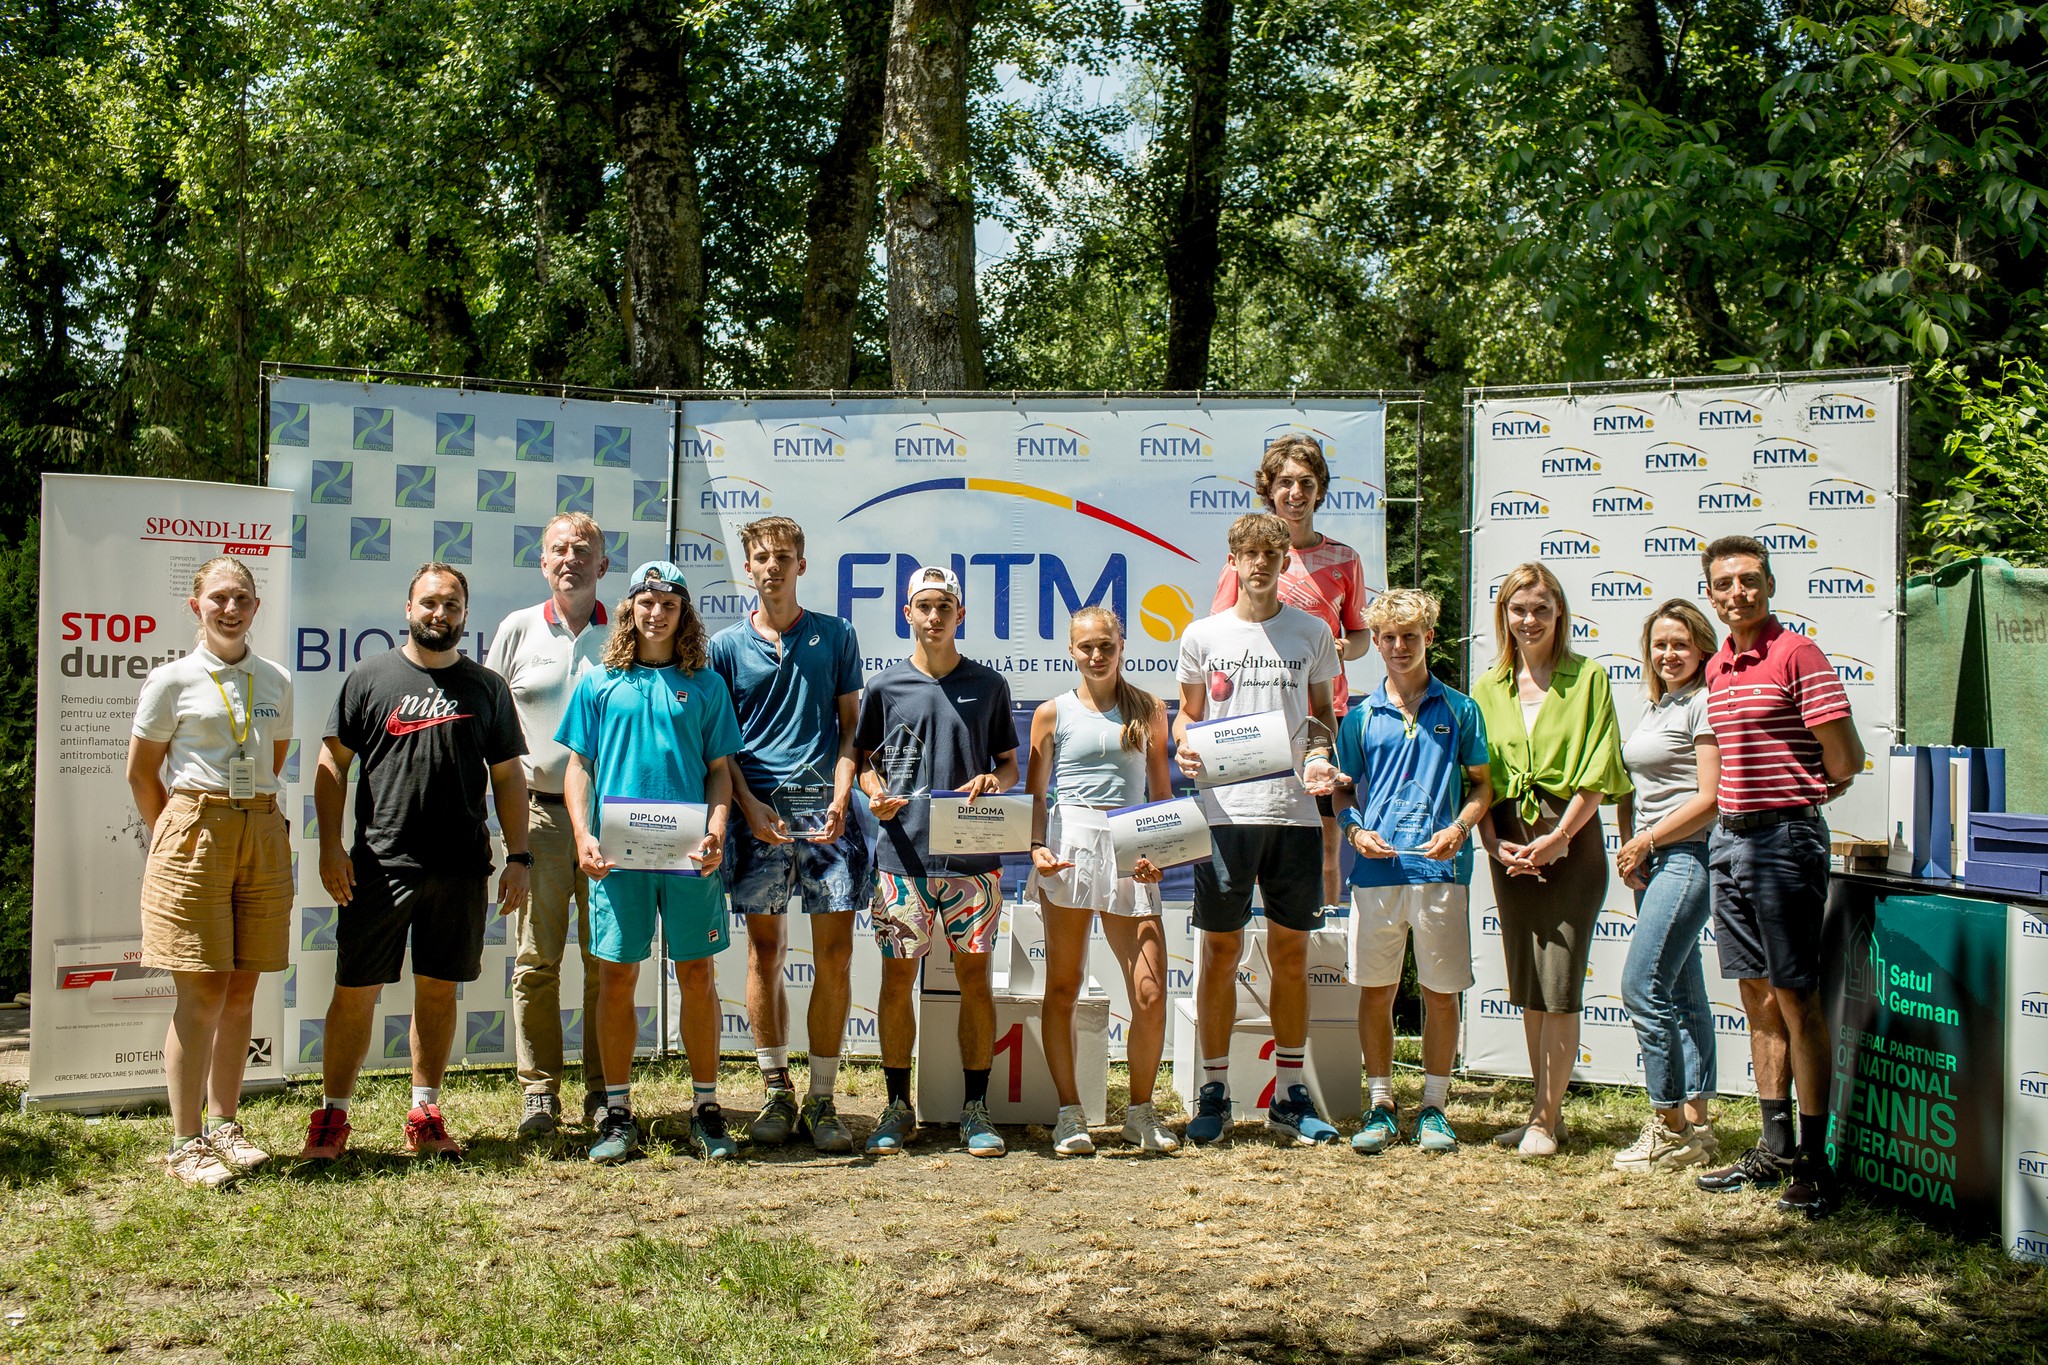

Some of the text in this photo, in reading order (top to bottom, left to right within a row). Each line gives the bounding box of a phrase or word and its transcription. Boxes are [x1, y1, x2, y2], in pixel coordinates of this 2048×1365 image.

[1700, 410, 1751, 426] FNTM
[1809, 404, 1864, 420] FNTM
[1492, 421, 1540, 436] FNTM
[1594, 415, 1643, 431] FNTM
[278, 438, 309, 447] BIOTEHNOS
[364, 444, 393, 452] BIOTEHNOS
[774, 438, 833, 456] FNTM
[895, 438, 954, 456] FNTM
[1018, 438, 1077, 456] FNTM
[1141, 438, 1200, 456] FNTM
[1645, 453, 1696, 468] FNTM
[1754, 448, 1806, 464] FNTM
[1542, 458, 1591, 473] FNTM
[701, 491, 759, 509] FNTM
[1191, 491, 1250, 509] FNTM
[1325, 492, 1375, 510] NTM
[1593, 497, 1642, 512] FNTM
[1698, 494, 1751, 509] FNTM
[1809, 490, 1864, 506] FNTM
[1491, 501, 1539, 516] FNTM
[146, 517, 272, 541] SPONDI-LIZ
[228, 545, 265, 556] cremă
[1540, 540, 1590, 556] FNTM
[1644, 538, 1696, 552] FNTM
[1592, 582, 1642, 597] FNTM
[1809, 579, 1864, 594] FNTM
[700, 596, 758, 614] FNTM
[61, 612, 156, 643] STOP
[1781, 622, 1805, 636] TM
[1996, 611, 2047, 643] head
[1018, 658, 1039, 672] DE
[1835, 666, 1862, 681] TM
[1242, 678, 1300, 690] strings & grips
[61, 694, 104, 705] Remediu
[400, 687, 458, 718] nike
[60, 709, 94, 720] pentru
[254, 708, 281, 719] FNTM
[74, 723, 110, 734] acțiune
[1214, 726, 1260, 738] DIPLOMA
[60, 736, 130, 746] antiinflamatoa
[59, 764, 113, 776] analgezică.
[630, 813, 677, 824] DIPLOMA
[958, 806, 1004, 816] DIPLOMA
[1136, 813, 1180, 826] DIPLOMA
[1483, 917, 1502, 930] FN
[1596, 922, 1636, 936] NTM
[2023, 921, 2048, 935] FNT
[124, 950, 142, 961] SPO
[1030, 948, 1044, 958] FN
[1168, 970, 1193, 988] TM
[1308, 973, 1340, 984] FNTM
[1890, 964, 1932, 994] Satul
[1890, 991, 1959, 1027] German
[2022, 1000, 2048, 1014] FNT
[848, 1018, 875, 1036] TM
[475, 1046, 504, 1054] BIOTEHNOS
[1840, 1024, 1957, 1072] GENERAL PARTNER
[994, 1023, 1023, 1102] 1
[54, 1074, 88, 1082] CERCETARE,
[90, 1070, 127, 1080] DEZVOLTARE
[1837, 1044, 1957, 1101] OF NATIONAL
[2020, 1079, 2048, 1094] FNT
[1836, 1071, 1956, 1148] TENNIS
[1826, 1112, 1956, 1180] FEDERATION
[2019, 1159, 2048, 1173] FNT
[1827, 1142, 1956, 1210] OF MOLDOVA
[2017, 1237, 2048, 1254] FNT
